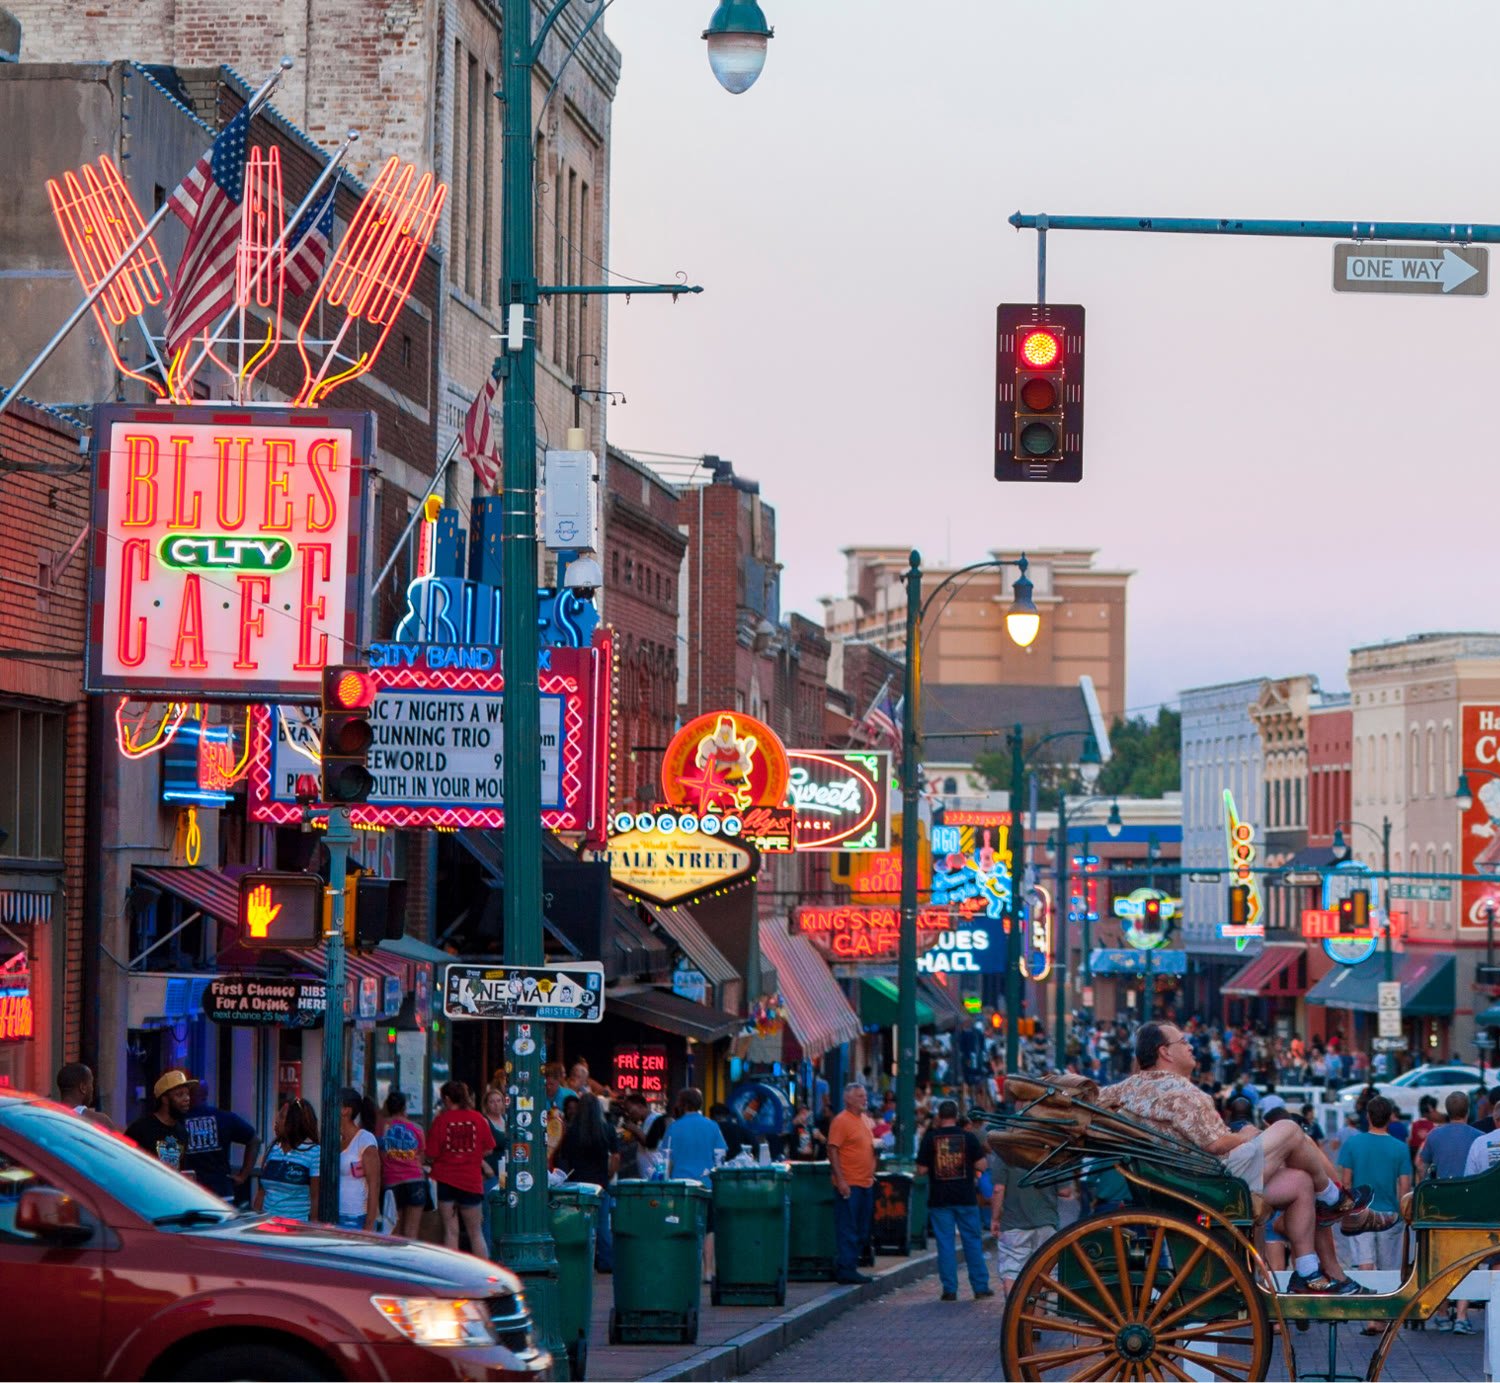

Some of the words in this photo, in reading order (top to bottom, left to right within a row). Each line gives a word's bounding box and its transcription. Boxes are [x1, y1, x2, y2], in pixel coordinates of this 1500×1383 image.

[1352, 259, 1393, 278] ONE
[1402, 261, 1444, 279] WAY
[121, 434, 338, 533] BLUES
[171, 538, 284, 564] CITY
[118, 537, 331, 671] CAFE
[369, 643, 417, 668] CITY
[427, 648, 493, 669] BAND
[395, 701, 403, 720] 7
[409, 701, 464, 722] NIGHTS
[471, 702, 484, 722] A
[369, 727, 446, 747] CUNNING
[452, 728, 490, 748] TRIO
[412, 777, 427, 796] IN
[432, 778, 471, 798] YOUR
[666, 853, 742, 869] STREET
[211, 982, 243, 995] First
[247, 983, 296, 998] Chance
[301, 985, 326, 997] RIBS
[216, 997, 237, 1010] For
[240, 998, 249, 1011] A
[252, 998, 289, 1012] Drink
[297, 997, 326, 1010] HERE
[213, 1011, 230, 1019] next
[232, 1011, 260, 1020] chance
[263, 1011, 273, 1020] 25
